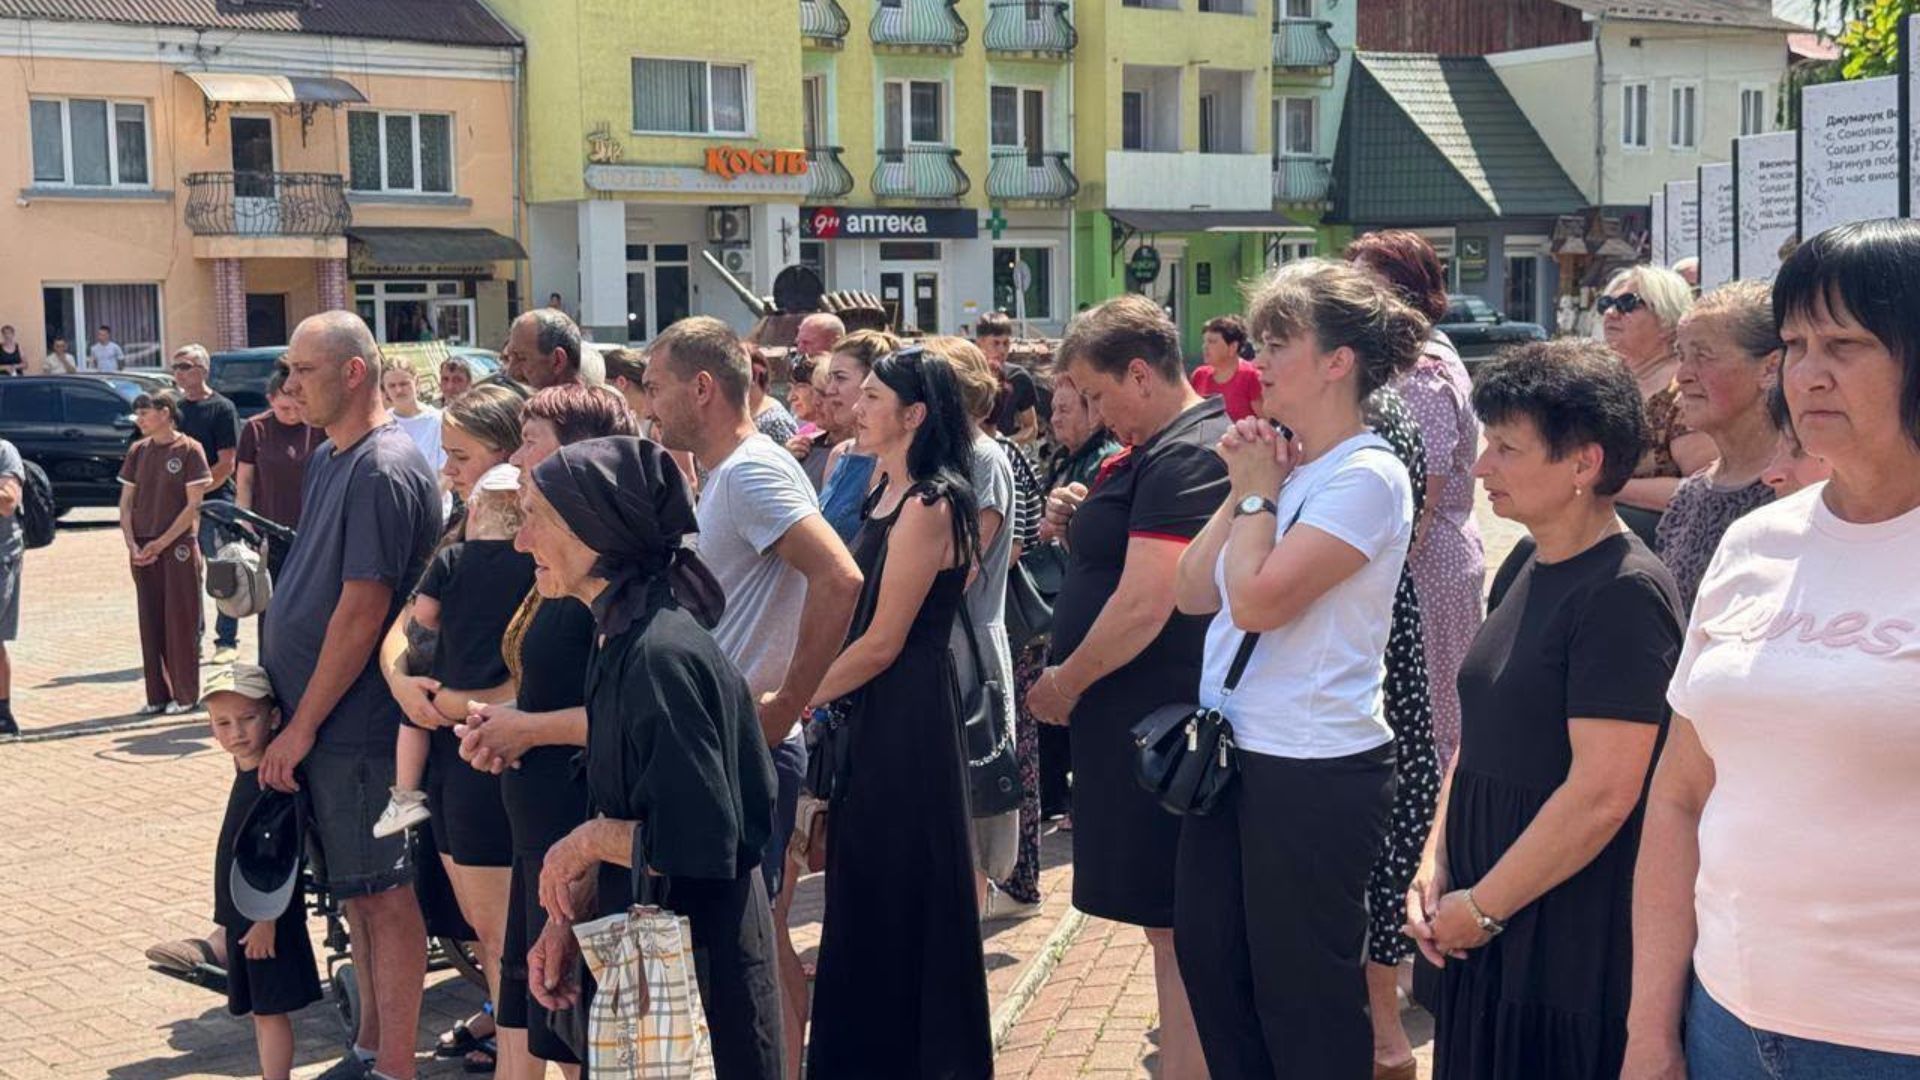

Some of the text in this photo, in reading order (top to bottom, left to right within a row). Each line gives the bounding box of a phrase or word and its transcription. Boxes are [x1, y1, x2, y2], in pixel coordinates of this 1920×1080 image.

[1826, 143, 1866, 156] Солдат
[1874, 153, 1898, 166] поб
[846, 215, 928, 233] аптека
